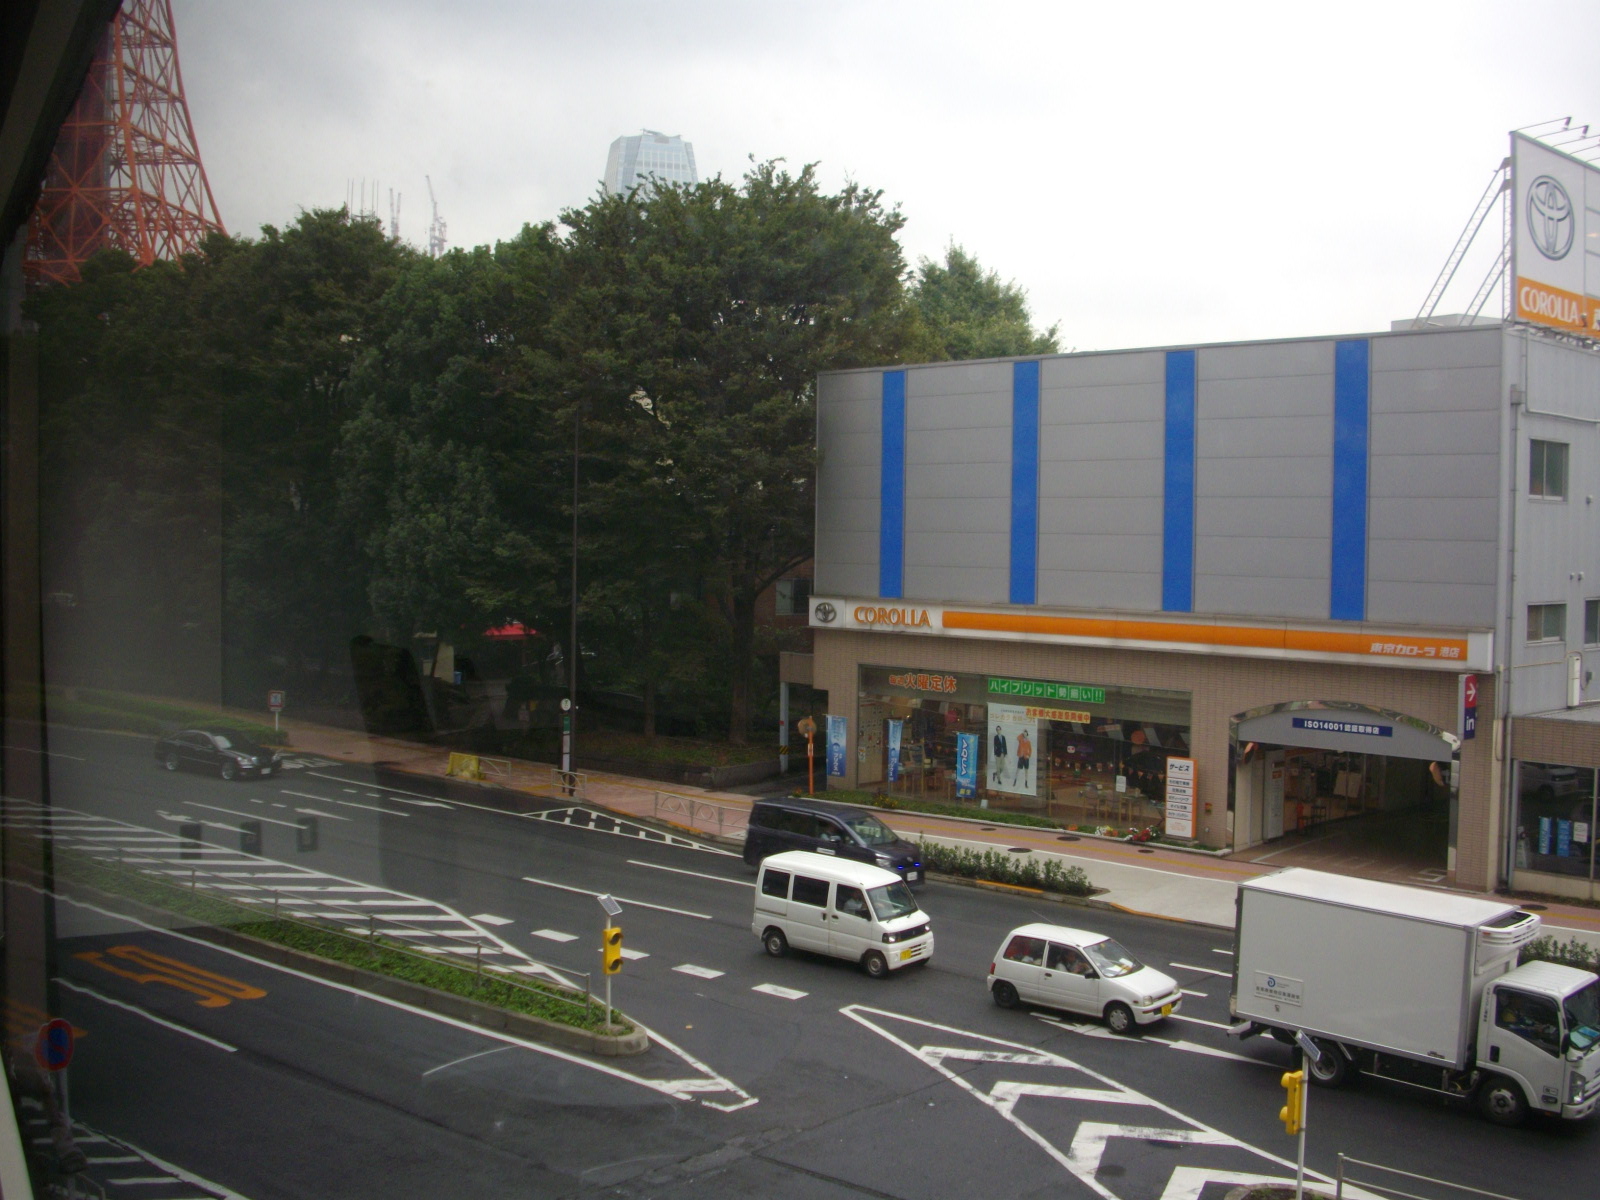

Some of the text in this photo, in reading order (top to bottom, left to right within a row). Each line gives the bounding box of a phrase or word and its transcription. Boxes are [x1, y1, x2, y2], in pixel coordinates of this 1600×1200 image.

[1520, 286, 1580, 327] COROLLA
[854, 606, 932, 628] COROLLA
[1370, 642, 1460, 658] 東京カローラ 港店
[1466, 716, 1475, 731] in
[960, 738, 968, 777] AQUA
[1169, 763, 1190, 772] サービス
